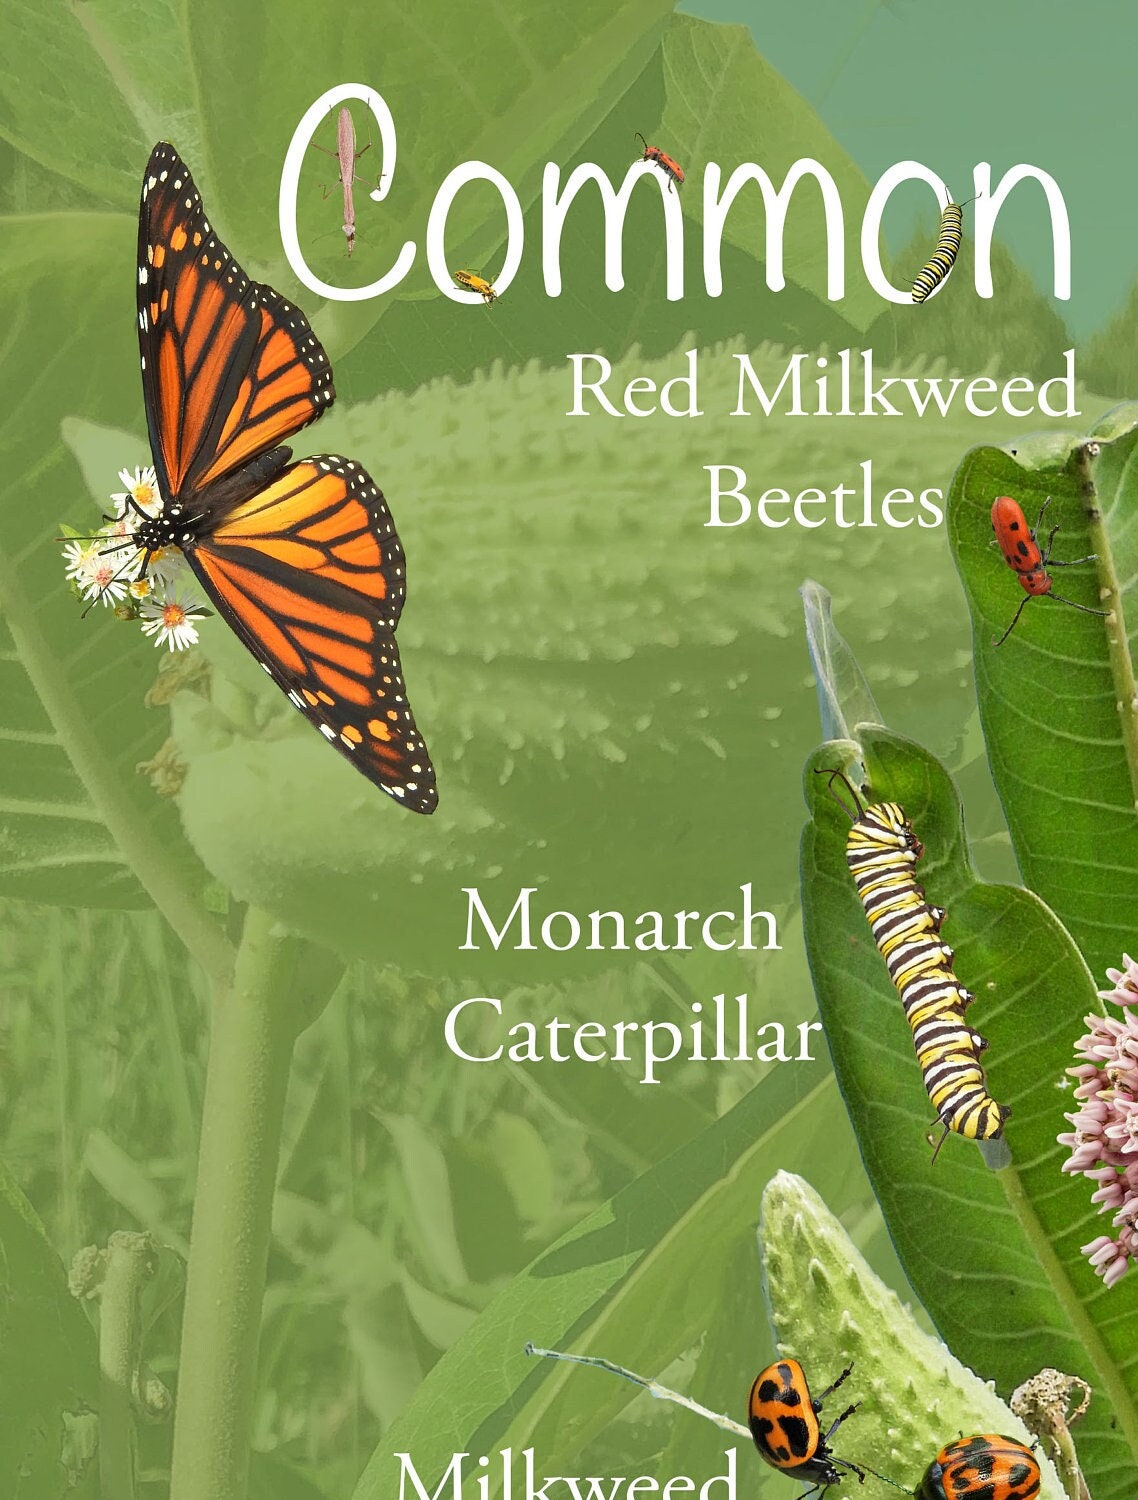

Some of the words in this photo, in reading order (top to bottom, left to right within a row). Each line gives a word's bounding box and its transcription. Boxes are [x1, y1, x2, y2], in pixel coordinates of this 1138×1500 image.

[278, 82, 1071, 305] Common
[565, 348, 704, 418] Red
[729, 348, 1082, 418] Milkweed
[702, 459, 943, 528] Beetles
[458, 882, 783, 951] Monarch
[444, 993, 823, 1083] Caterpillar
